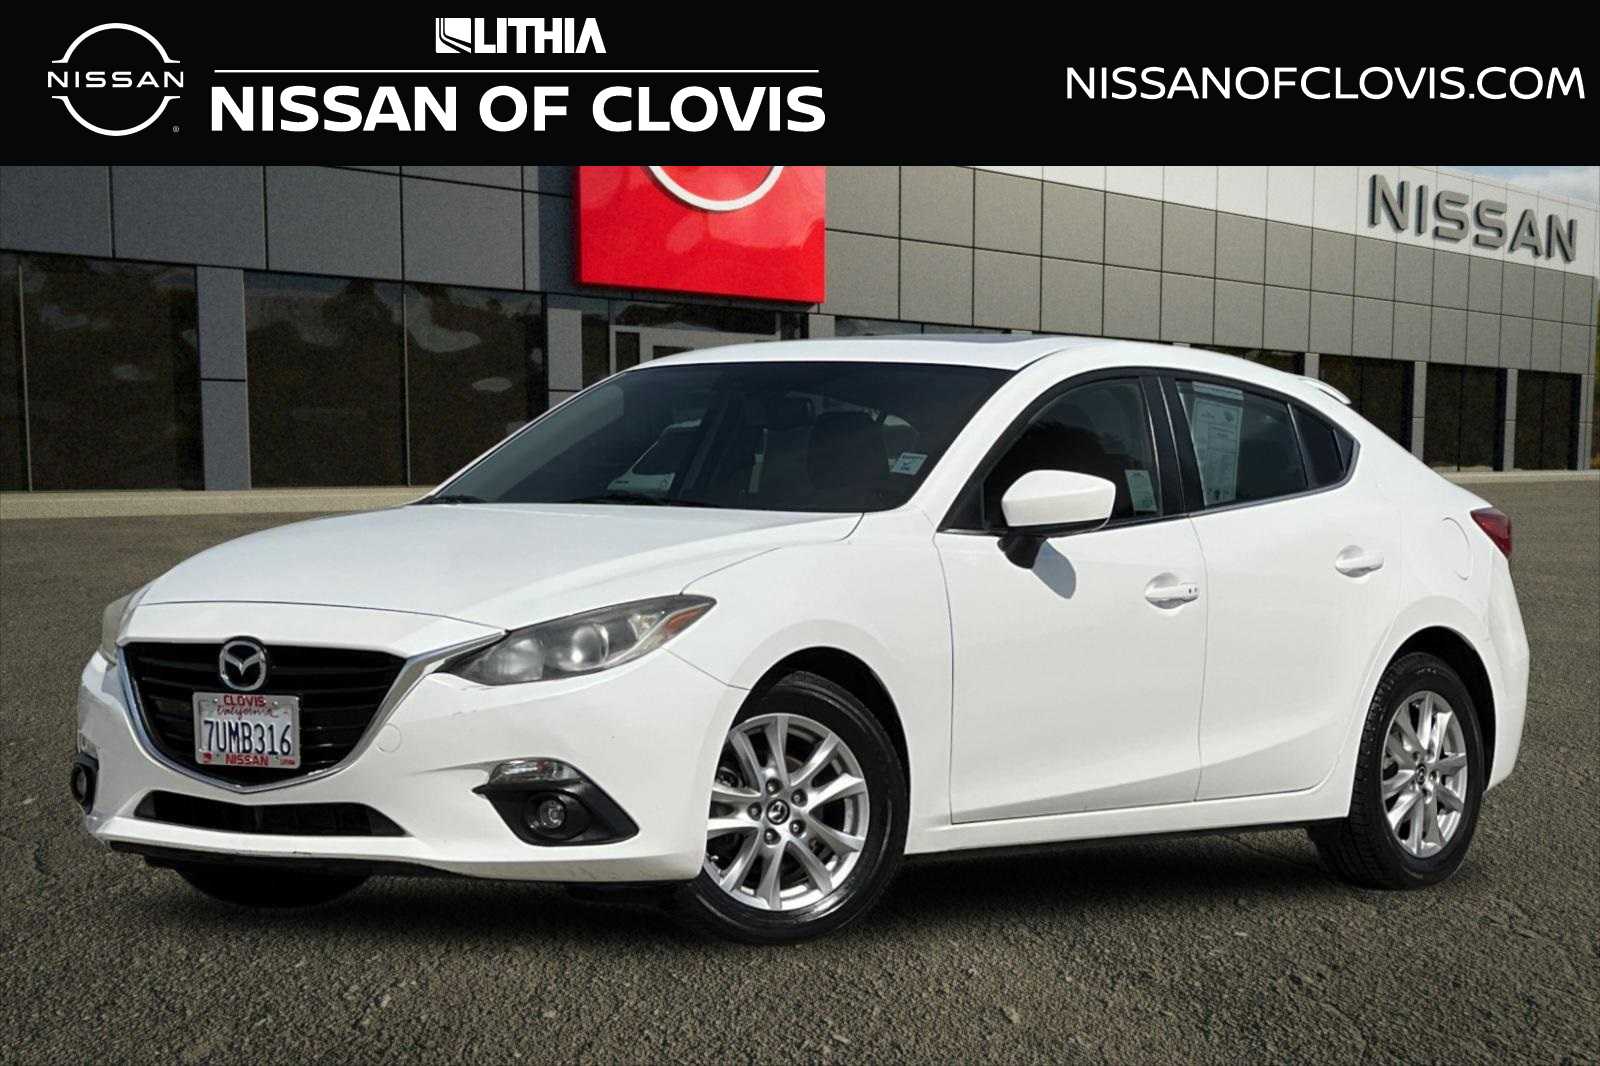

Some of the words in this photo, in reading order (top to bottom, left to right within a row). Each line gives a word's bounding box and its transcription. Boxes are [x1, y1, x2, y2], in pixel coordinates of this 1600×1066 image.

[1368, 174, 1577, 263] NISSAN
[223, 695, 266, 707] CLOVIS
[204, 720, 291, 756] 7UMB316
[225, 753, 269, 766] NISSAN
